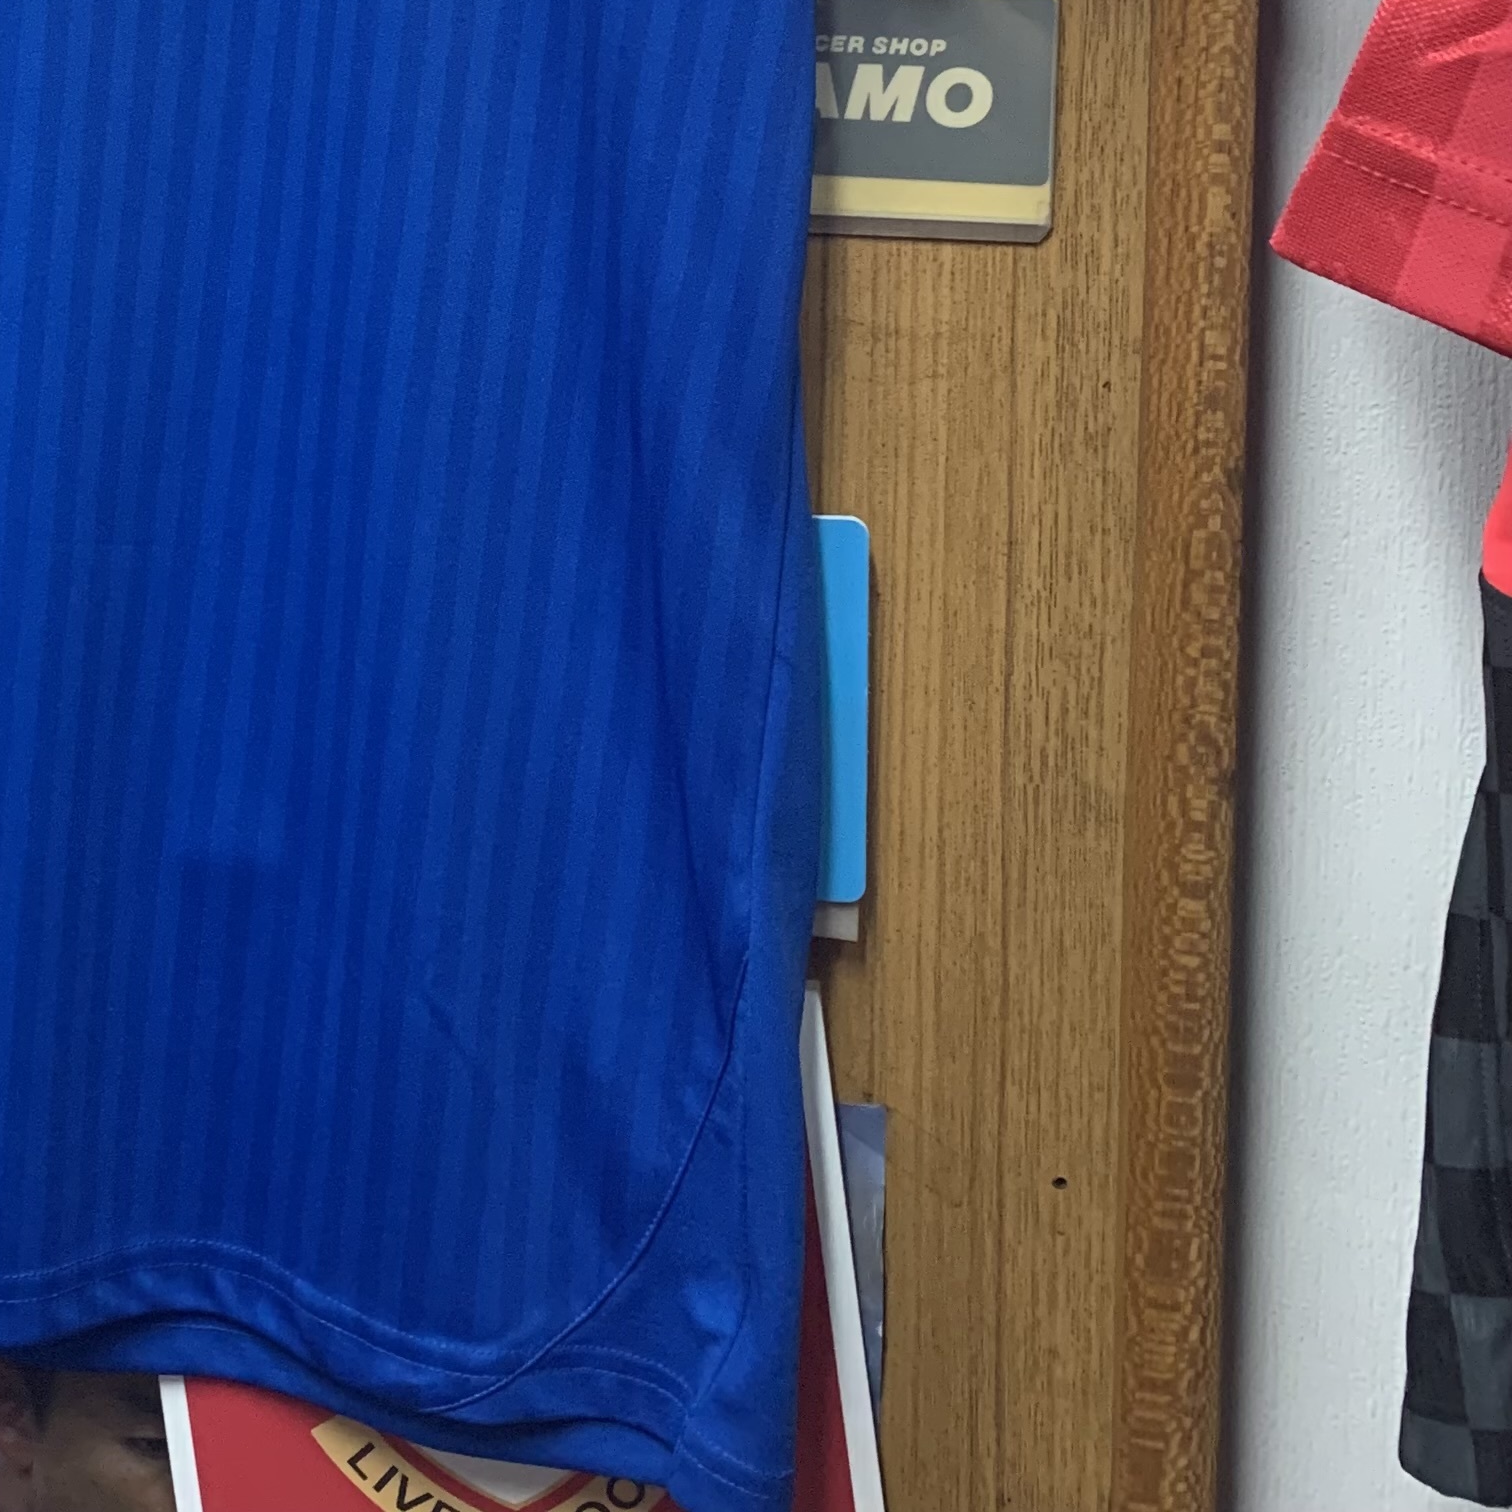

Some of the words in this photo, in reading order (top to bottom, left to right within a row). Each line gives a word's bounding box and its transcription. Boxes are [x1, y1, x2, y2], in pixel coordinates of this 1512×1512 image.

[815, 34, 865, 54] CER
[872, 36, 947, 57] SHOP
[815, 61, 994, 129] AMO
